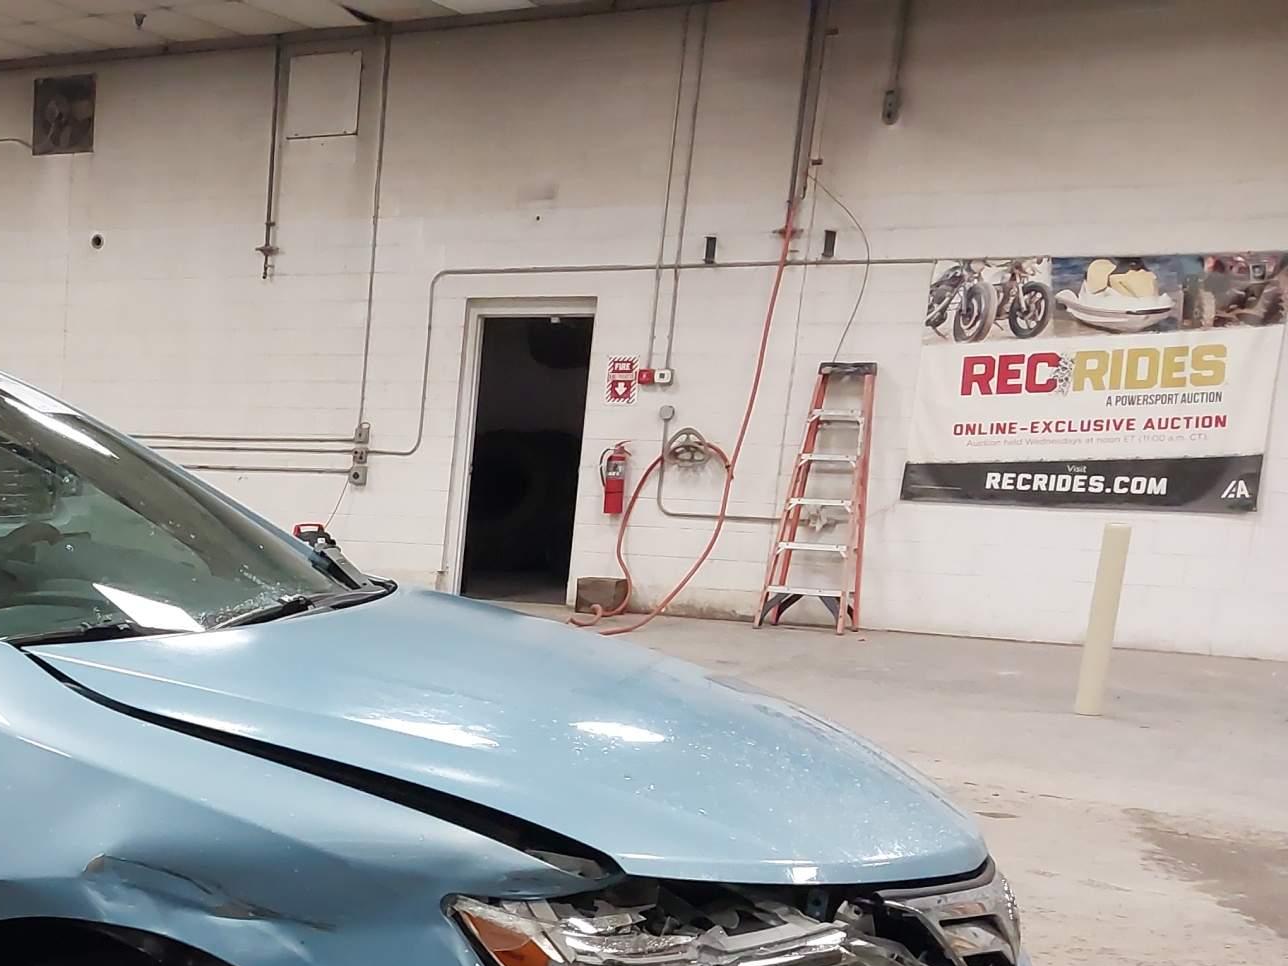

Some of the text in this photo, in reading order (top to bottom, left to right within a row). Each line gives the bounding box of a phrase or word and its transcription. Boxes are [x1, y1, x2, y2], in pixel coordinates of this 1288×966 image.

[614, 362, 631, 370] FIRE
[961, 344, 1227, 396] REC RIDES
[1106, 391, 1223, 407] A POWERSPORT AUCTION
[953, 415, 1228, 436] ONLINE-EXCLUSIVE AUCTION
[966, 438, 1001, 447] Auction
[1026, 436, 1082, 446] Wednesdays
[1066, 464, 1087, 473] Visit
[985, 472, 1168, 495] RECRIDES.COM
